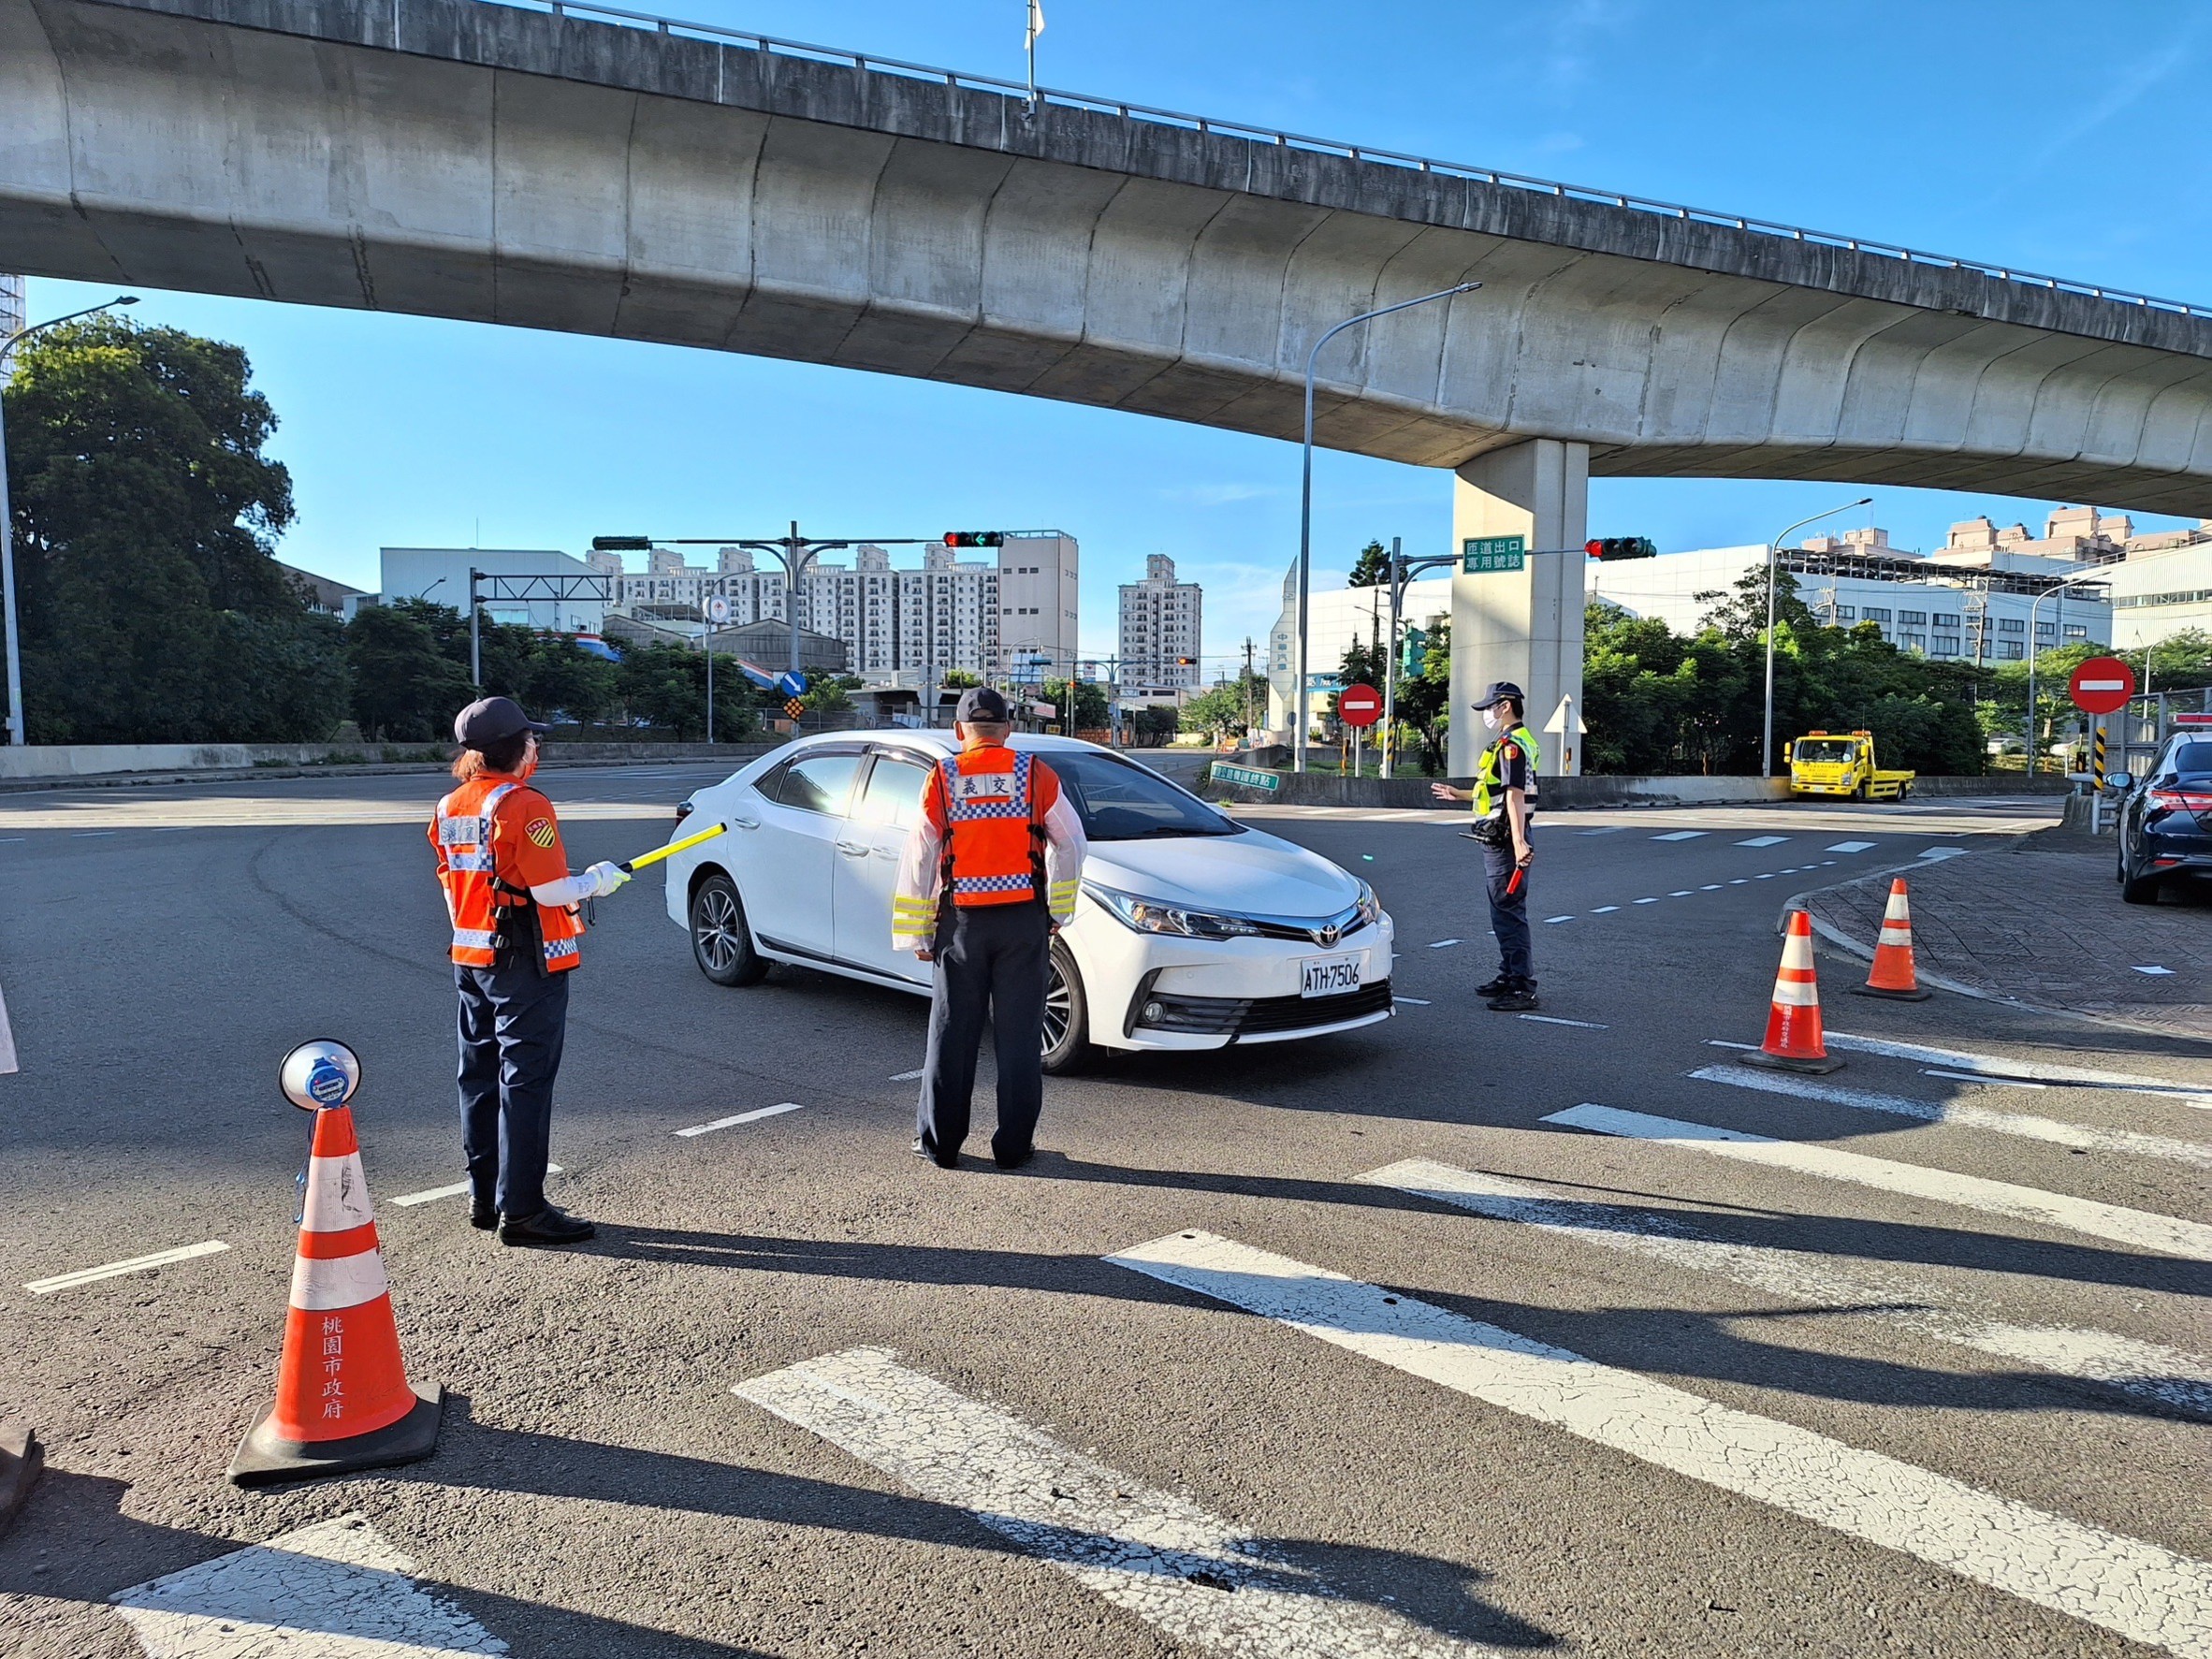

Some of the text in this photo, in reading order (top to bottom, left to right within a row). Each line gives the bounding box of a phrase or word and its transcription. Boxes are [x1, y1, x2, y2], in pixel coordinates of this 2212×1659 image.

[1466, 541, 1520, 555] 匝道出口
[1466, 554, 1521, 570] 專用號誌
[962, 777, 1010, 795] 義交
[1303, 963, 1360, 992] ATH-7506
[321, 1316, 345, 1419] 桃園市政府
